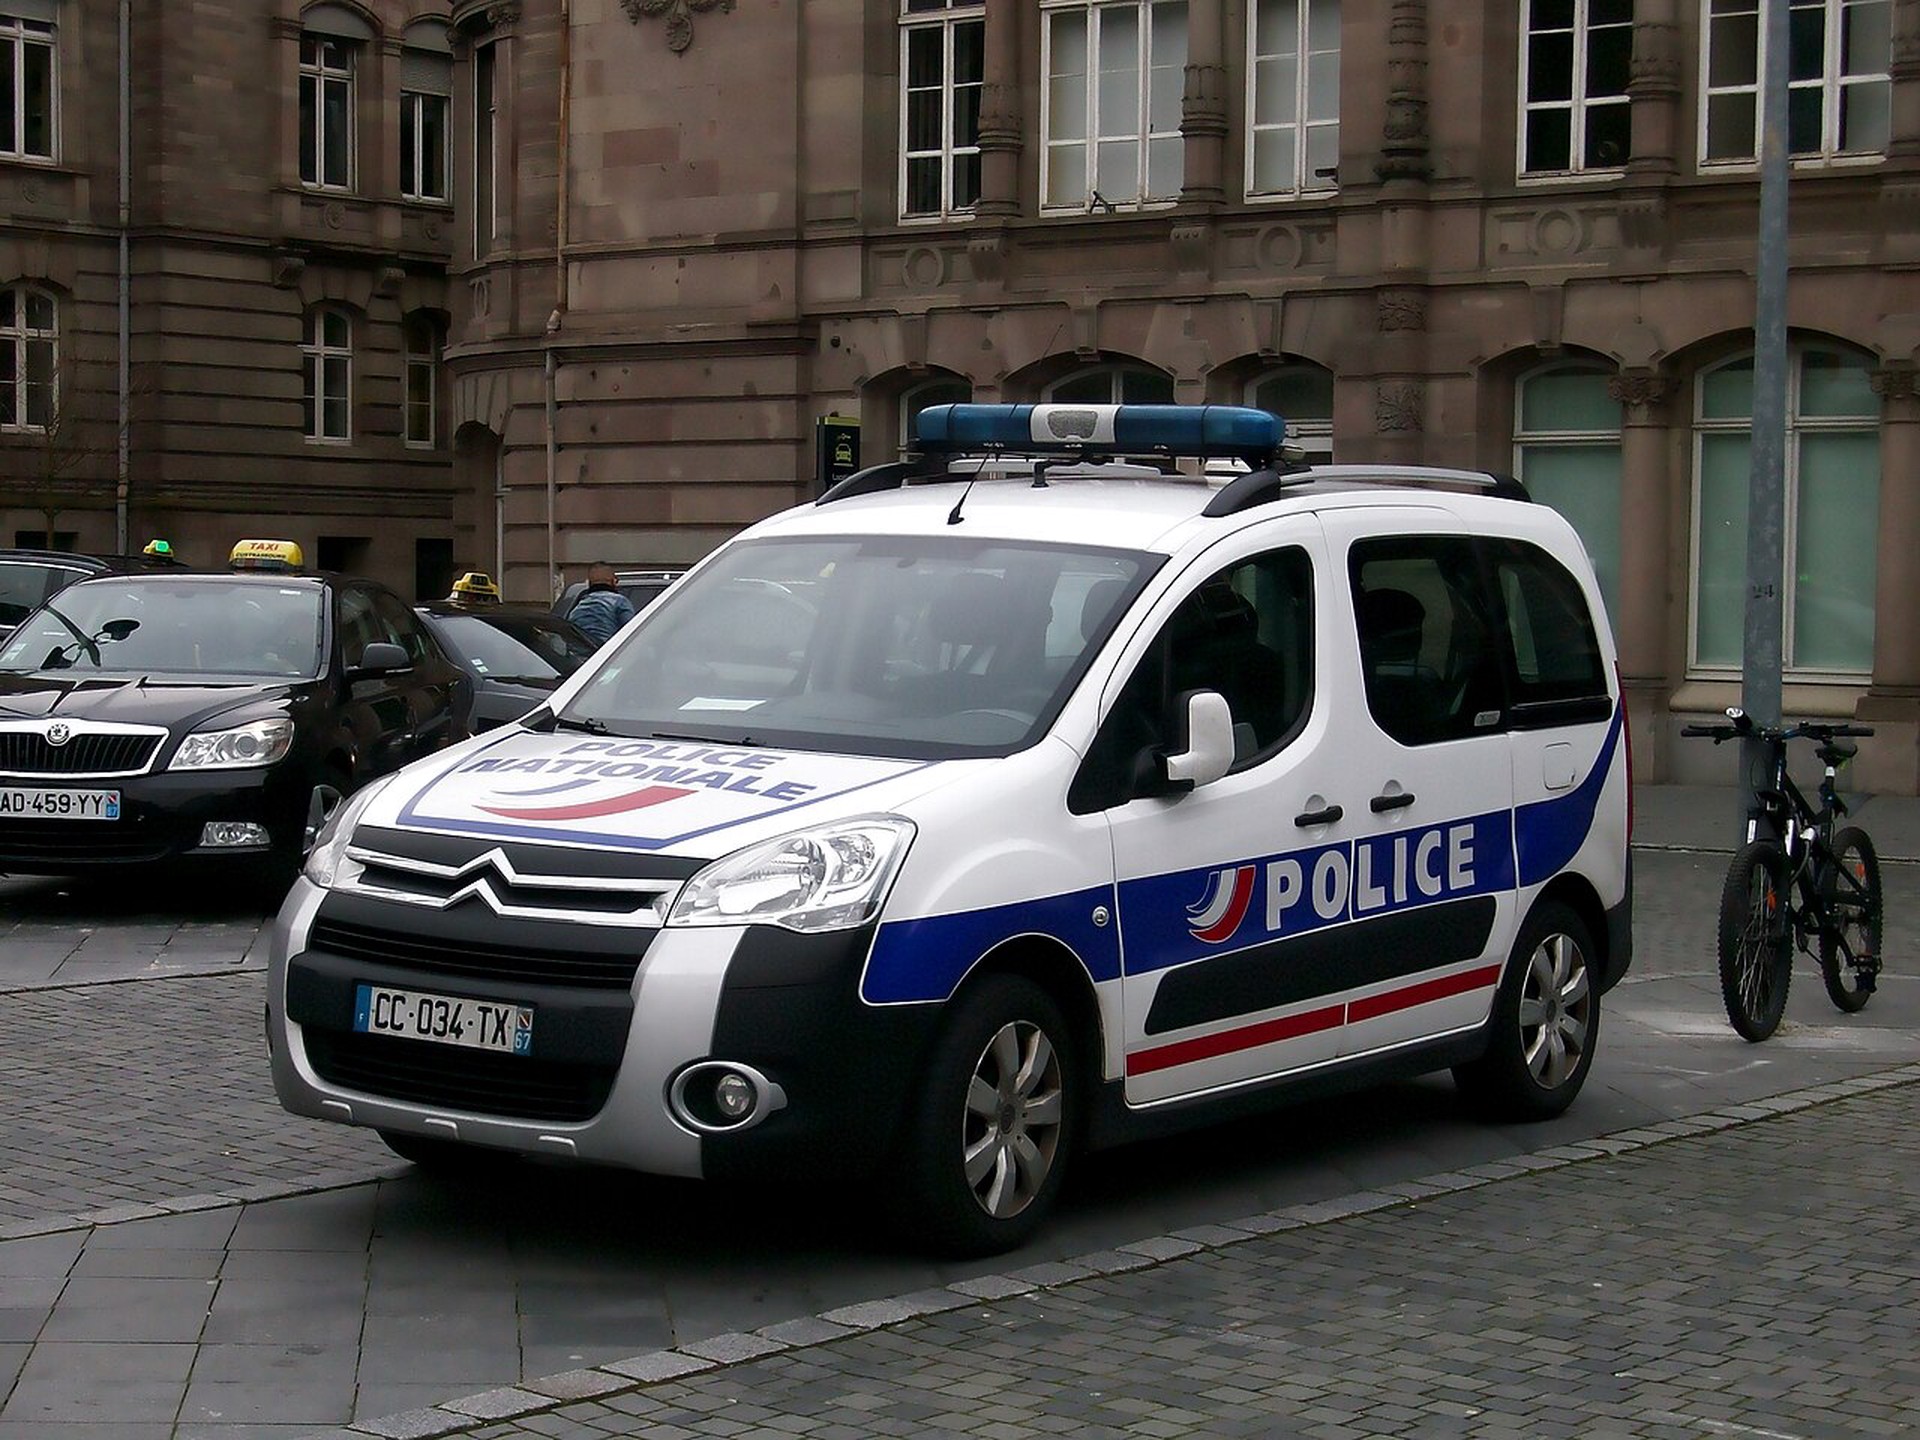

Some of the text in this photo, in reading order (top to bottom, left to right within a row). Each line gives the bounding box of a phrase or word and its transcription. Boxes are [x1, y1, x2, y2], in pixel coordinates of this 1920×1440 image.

[249, 542, 279, 551] TAXI
[560, 741, 786, 770] POLICE
[458, 758, 817, 802] NATIONALE
[0, 792, 104, 815] AD-459-YY
[1265, 823, 1475, 932] POLICE
[515, 1031, 531, 1050] 67
